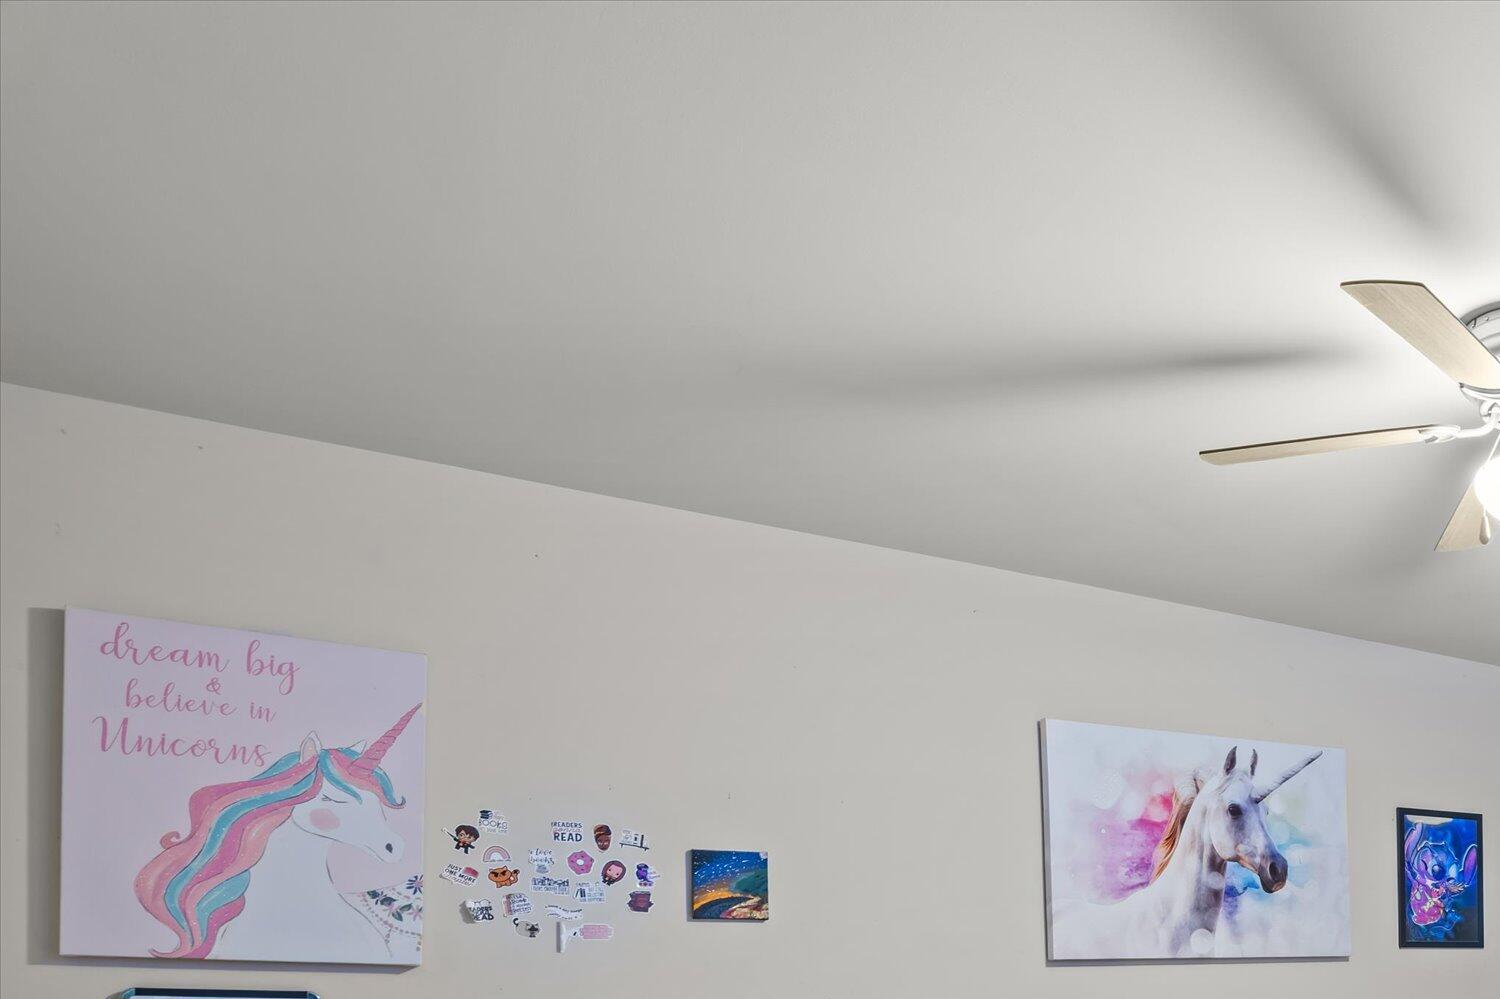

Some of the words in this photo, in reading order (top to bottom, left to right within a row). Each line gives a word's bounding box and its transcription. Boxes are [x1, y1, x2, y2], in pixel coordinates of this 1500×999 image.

[100, 622, 230, 673] dream
[246, 639, 301, 696] big
[125, 678, 238, 716] believe
[250, 702, 277, 723] in
[205, 677, 222, 695] &
[92, 716, 272, 767] Unicorns
[553, 832, 583, 842] READ
[458, 873, 476, 884] MORE
